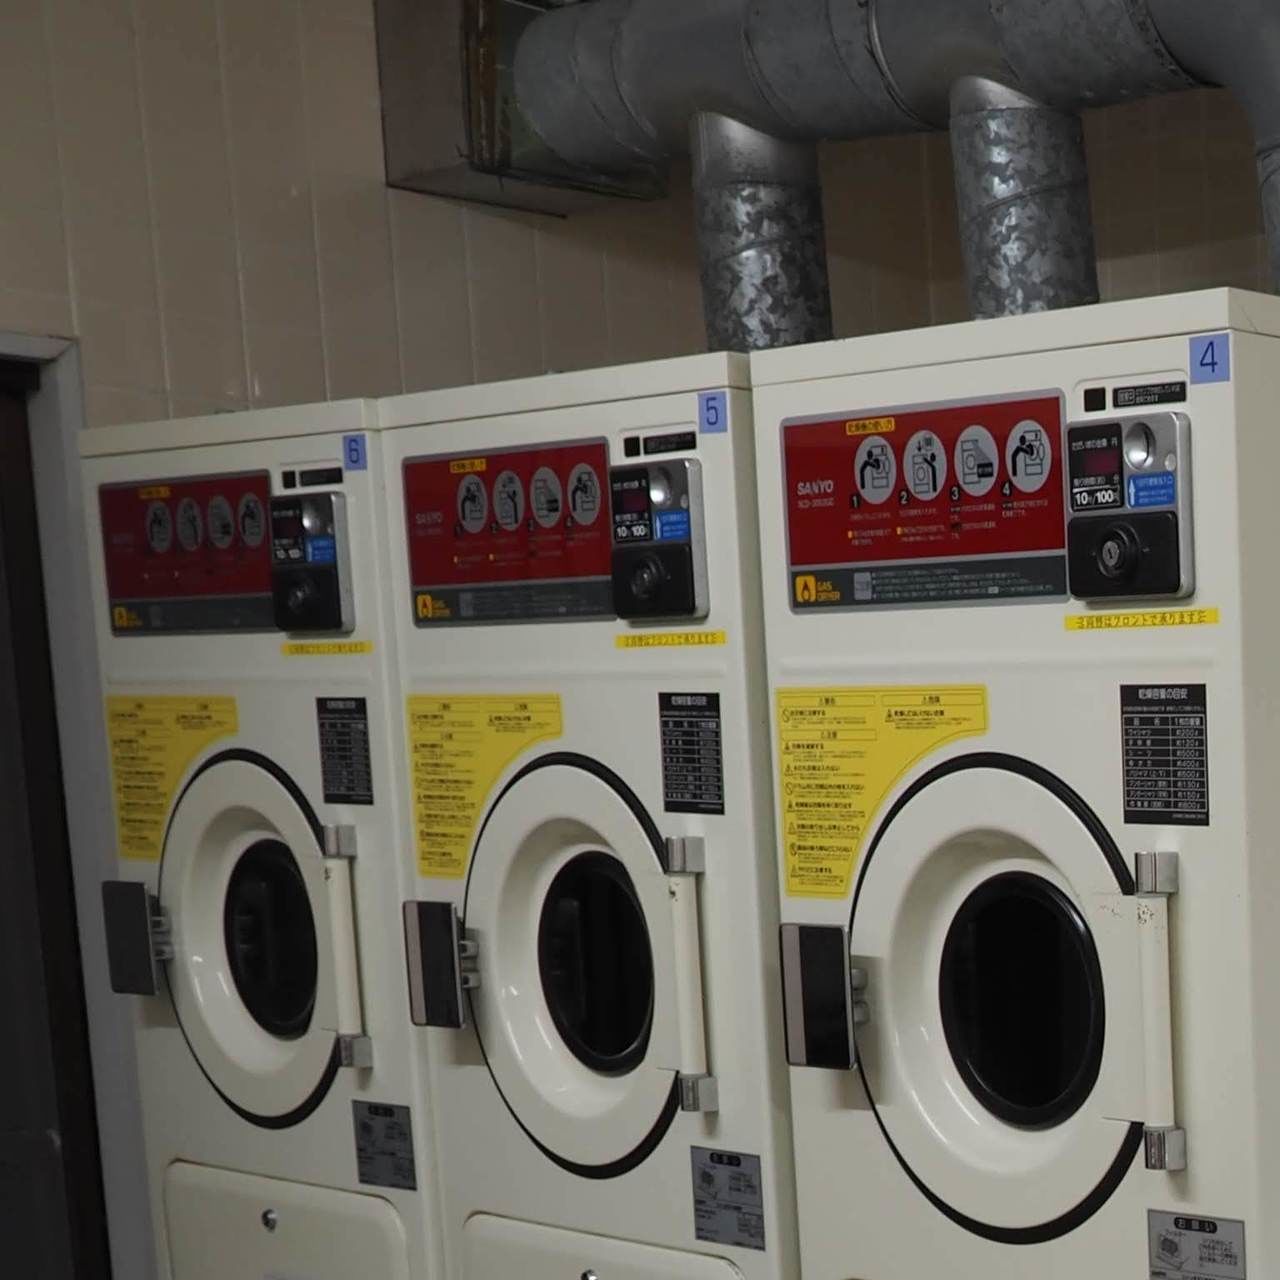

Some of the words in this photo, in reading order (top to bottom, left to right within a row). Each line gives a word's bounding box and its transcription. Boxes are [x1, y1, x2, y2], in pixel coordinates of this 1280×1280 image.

[1198, 340, 1218, 374] 4
[705, 397, 718, 427] 5
[347, 438, 360, 464] 6
[797, 480, 833, 496] SANYO
[951, 486, 960, 500] 3
[1002, 482, 1011, 497] 4
[852, 496, 859, 508] 1
[900, 491, 908, 505] 2
